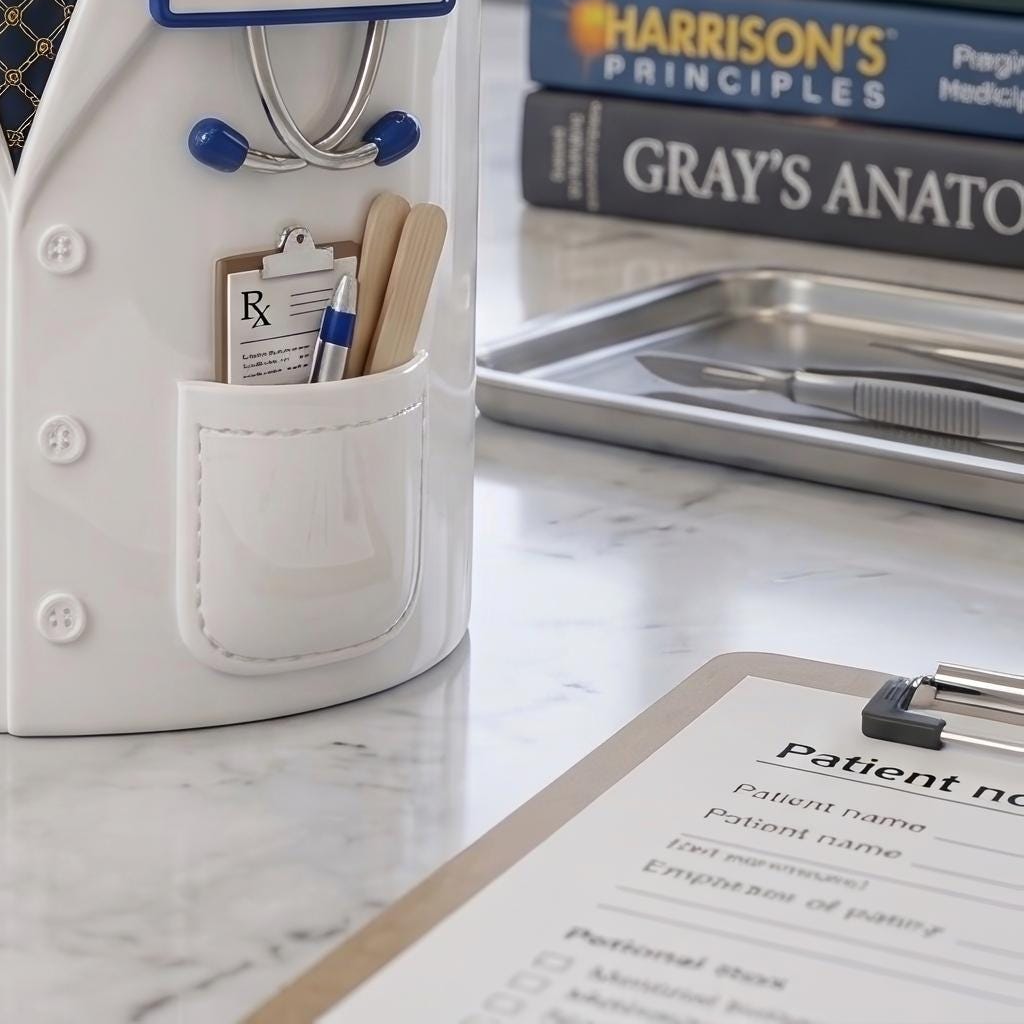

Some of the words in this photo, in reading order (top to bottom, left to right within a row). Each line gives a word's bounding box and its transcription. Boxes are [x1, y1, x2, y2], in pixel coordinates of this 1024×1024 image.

[604, 3, 886, 77] HARRISON'S
[603, 55, 886, 110] PRINCIPLES
[622, 137, 812, 211] GRAY'S
[822, 161, 1024, 236] ANATO
[775, 742, 960, 793] Patient
